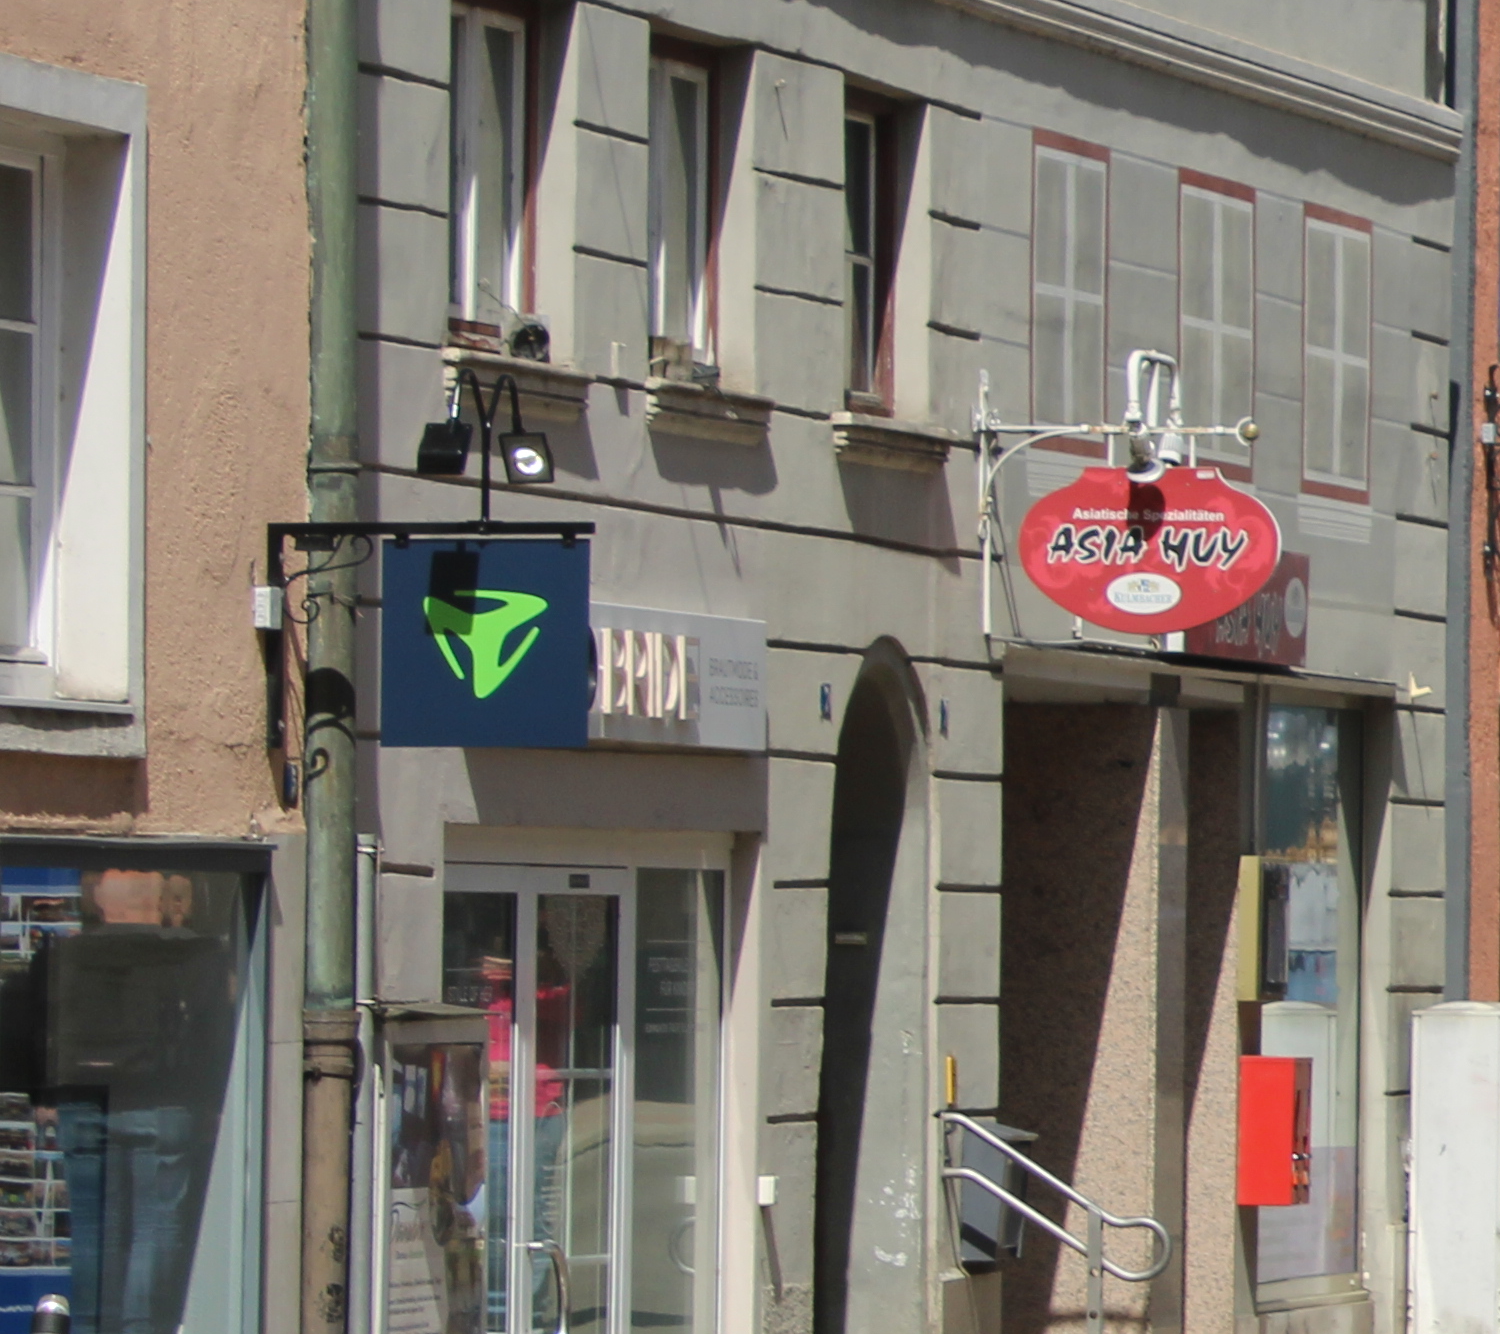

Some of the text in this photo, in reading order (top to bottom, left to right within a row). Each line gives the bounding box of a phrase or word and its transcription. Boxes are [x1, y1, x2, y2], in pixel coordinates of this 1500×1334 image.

[1073, 508, 1225, 522] Asiatische Spezialitäten
[1047, 524, 1249, 572] ASIA HUY
[1113, 591, 1173, 604] KULMBACHER
